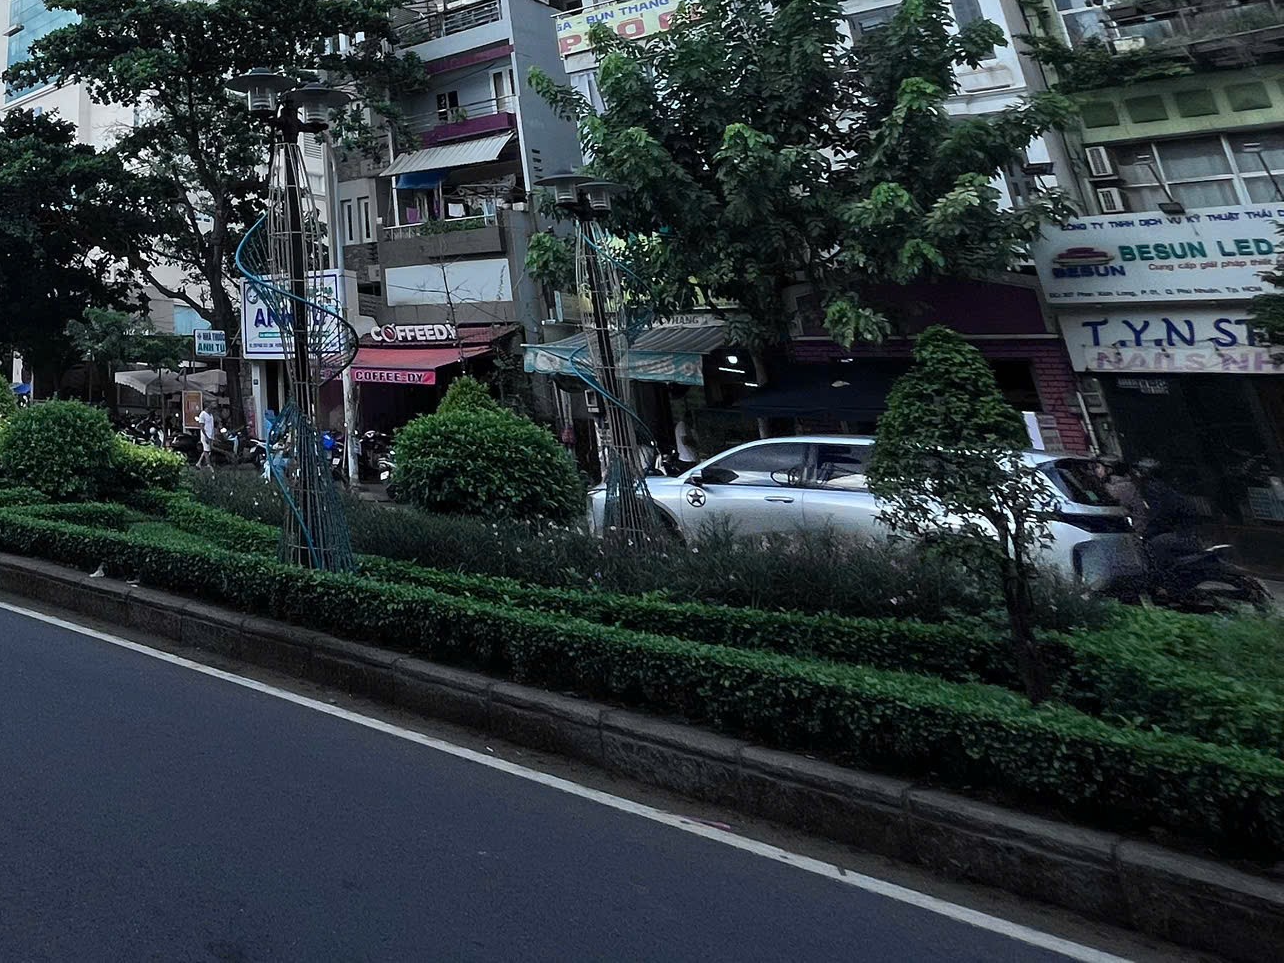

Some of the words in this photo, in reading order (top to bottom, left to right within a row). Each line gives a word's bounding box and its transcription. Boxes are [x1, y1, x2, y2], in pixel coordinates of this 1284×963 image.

[1108, 220, 1135, 228] TNHH
[1118, 241, 1207, 262] BESUN
[1216, 238, 1274, 257] LED
[1148, 263, 1174, 271] Cung
[1221, 259, 1247, 268] pháp
[1052, 265, 1126, 279] BESUN
[198, 343, 214, 351] ANH
